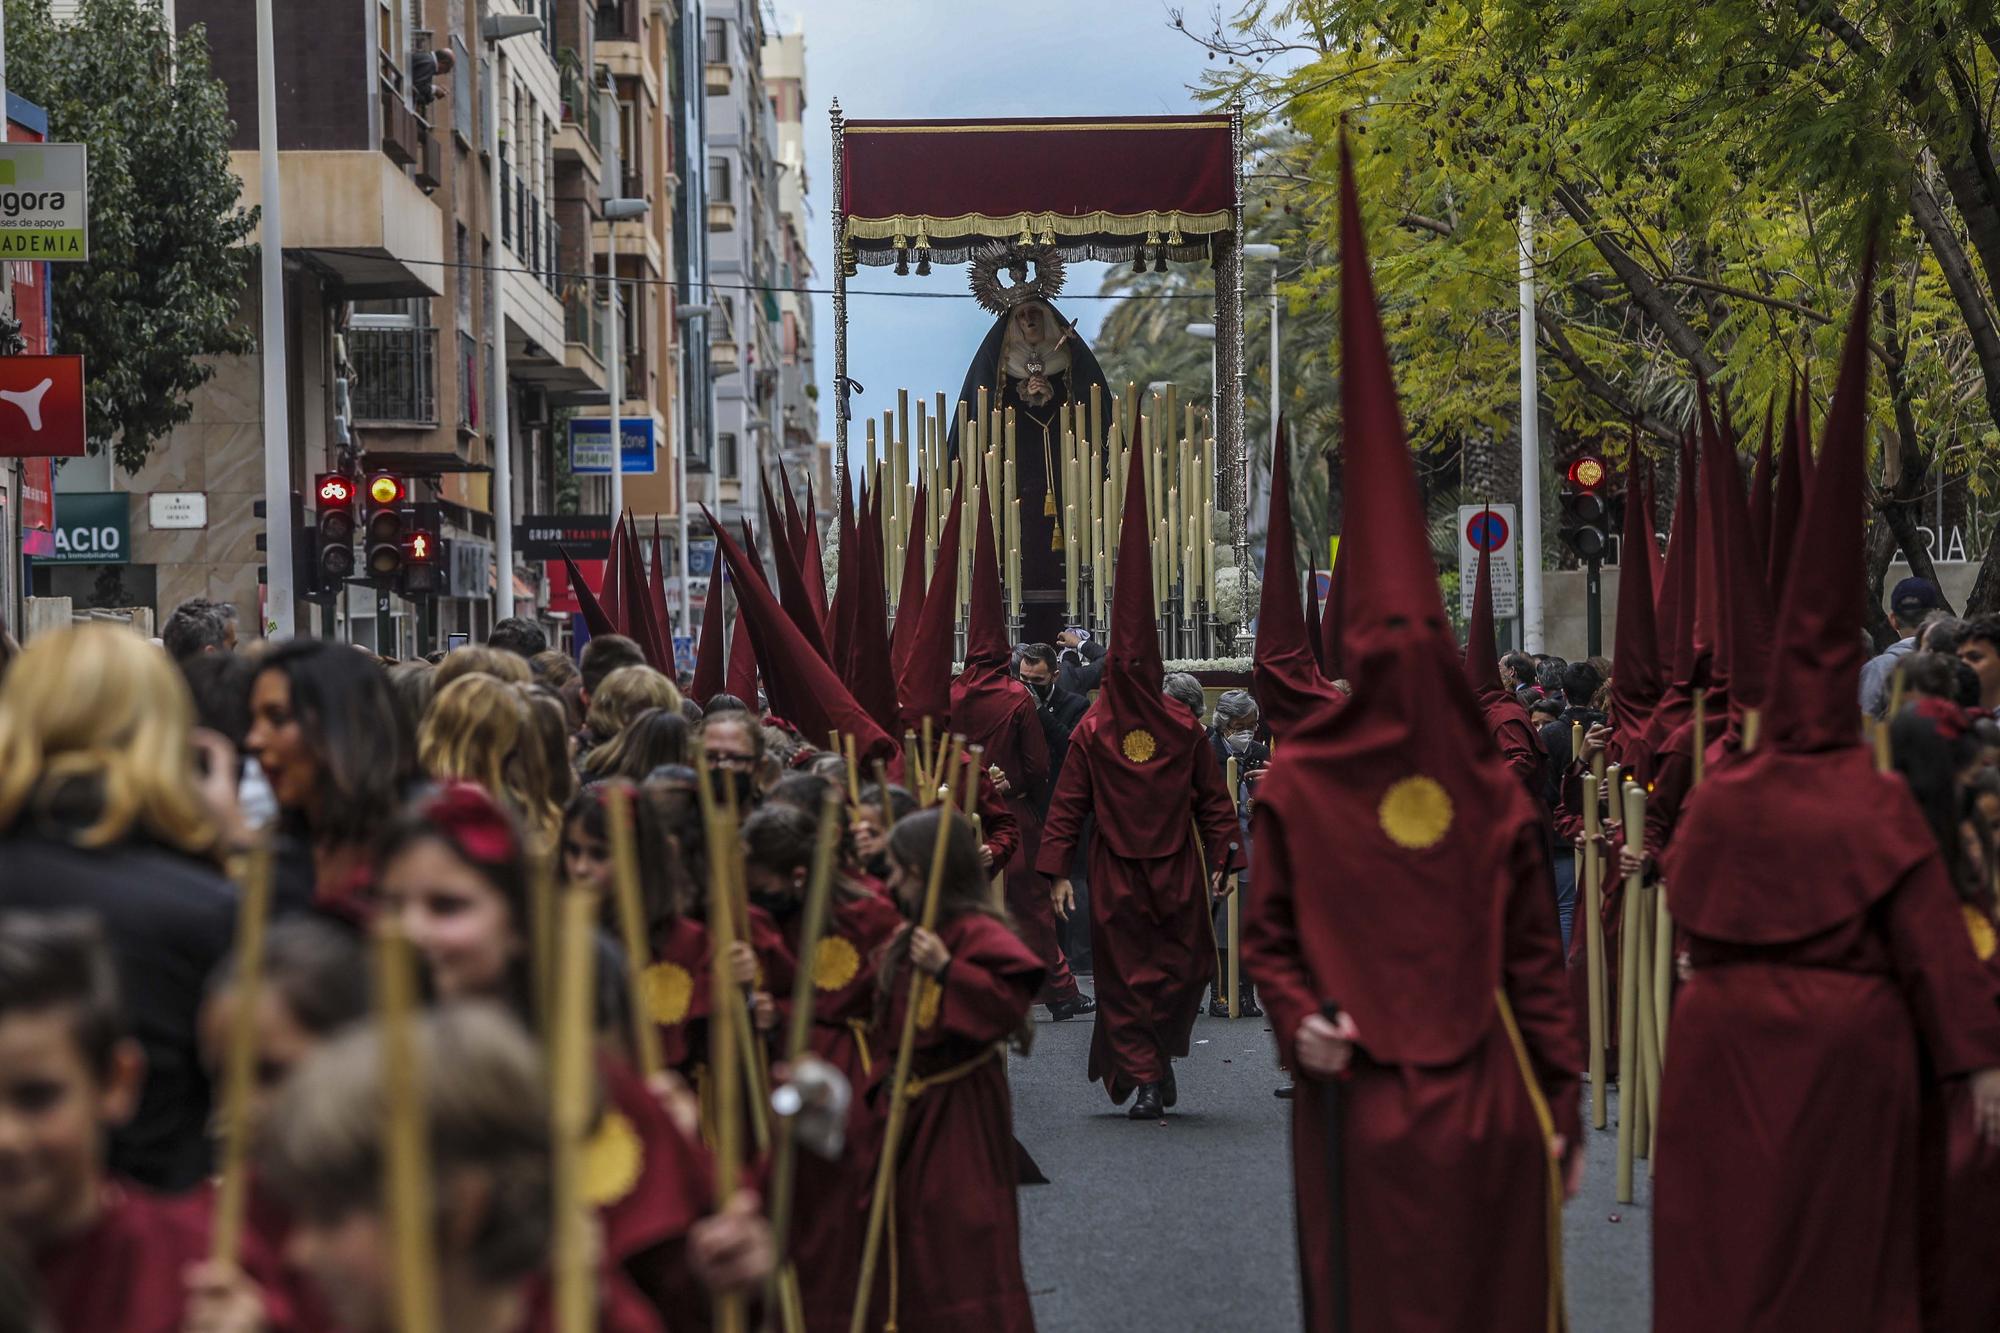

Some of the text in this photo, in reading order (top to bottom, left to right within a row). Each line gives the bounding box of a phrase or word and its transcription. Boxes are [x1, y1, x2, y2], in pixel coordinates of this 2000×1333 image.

[0, 192, 65, 216] gora
[19, 218, 32, 228] de
[34, 220, 65, 230] apoyo
[528, 529, 561, 541] GRUPO
